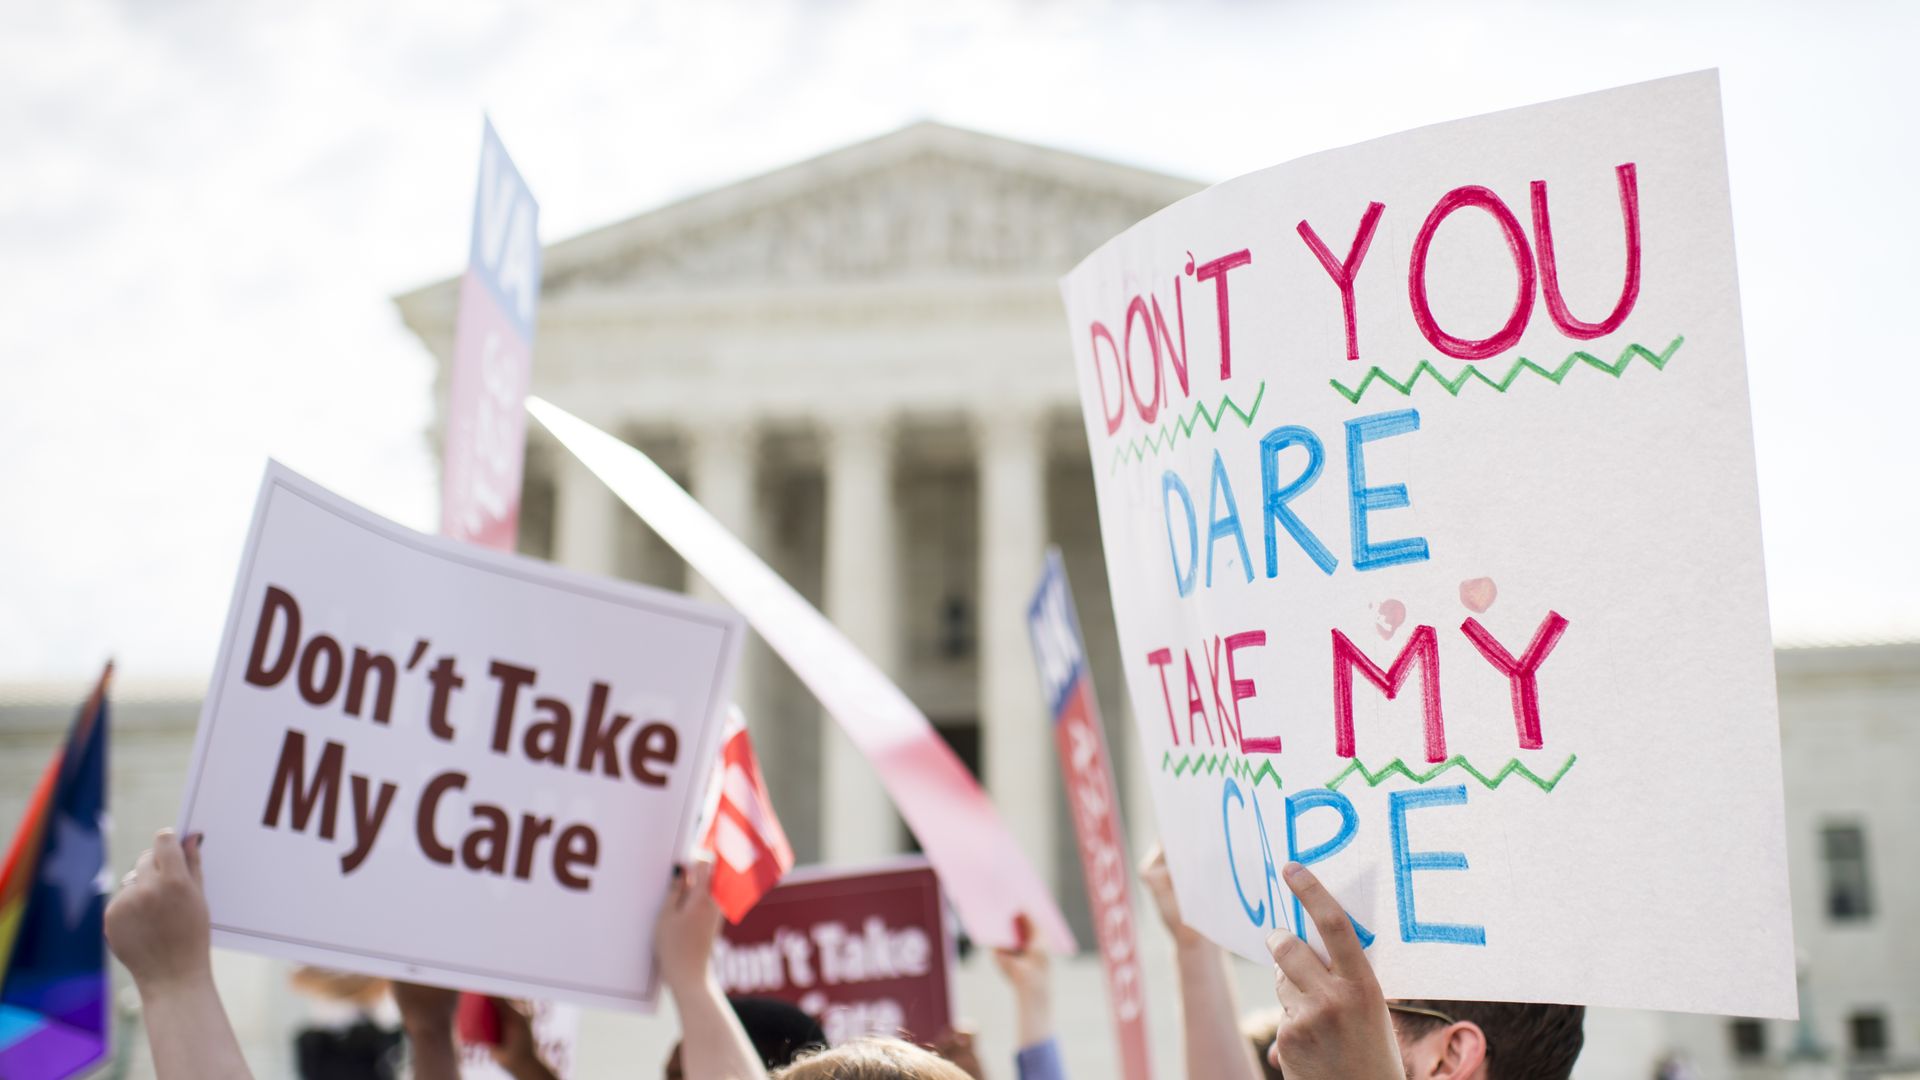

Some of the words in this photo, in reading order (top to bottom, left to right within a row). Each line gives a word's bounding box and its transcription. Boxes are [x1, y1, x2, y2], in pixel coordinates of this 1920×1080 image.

[1090, 249, 1252, 436] DON'T
[1296, 162, 1641, 361] YOU
[1162, 408, 1430, 597] DARE
[244, 585, 465, 742] Don't
[488, 659, 679, 788] Take
[1147, 629, 1283, 755] TAKE
[1330, 609, 1569, 764] MY
[261, 729, 398, 876] My
[415, 771, 600, 892] Care
[1222, 777, 1487, 950] CARE
[810, 917, 931, 986] Take
